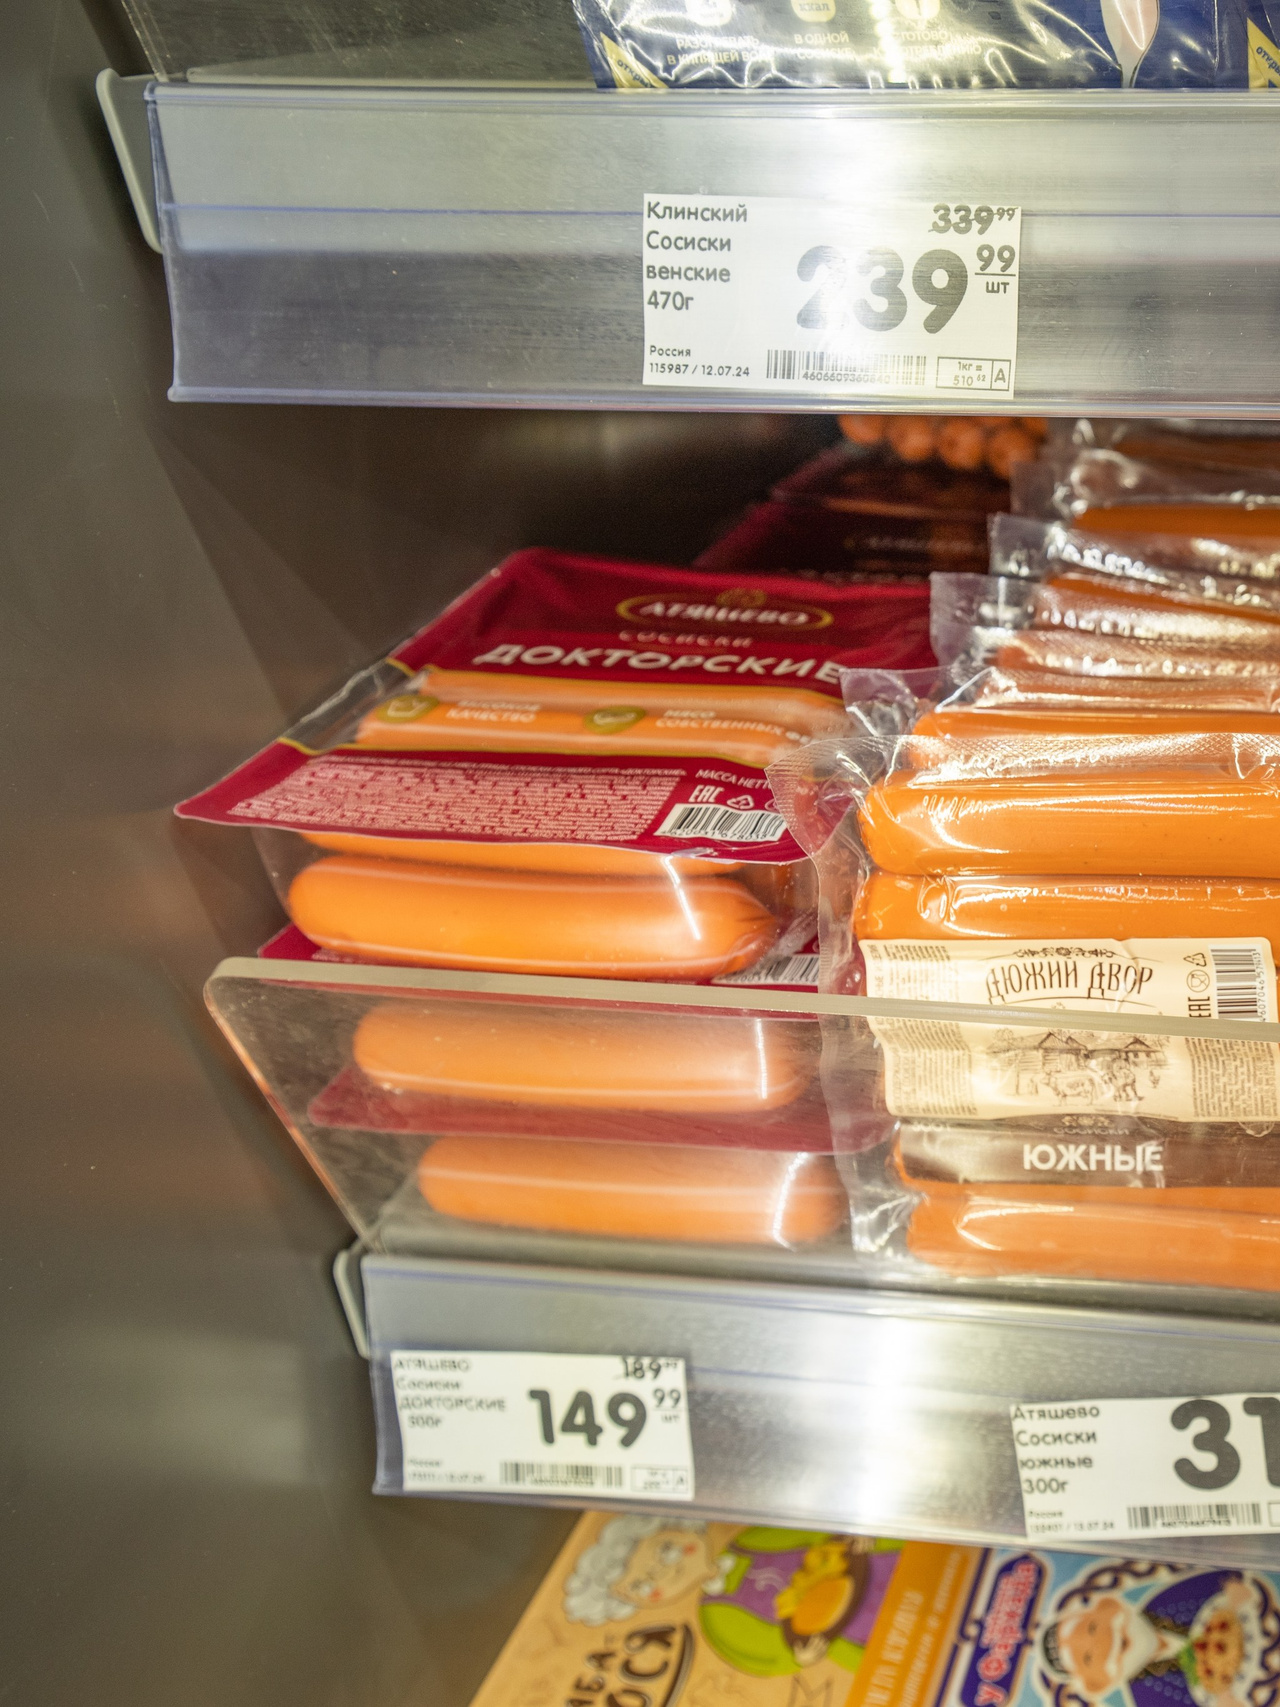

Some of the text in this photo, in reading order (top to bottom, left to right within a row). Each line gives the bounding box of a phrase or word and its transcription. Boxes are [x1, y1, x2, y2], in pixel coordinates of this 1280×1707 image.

[795, 30, 849, 45] В ОДНОЙ
[667, 55, 676, 66] В
[647, 201, 748, 223] Клинский
[931, 203, 1017, 236] 339 99
[646, 230, 732, 252] Сосиски
[646, 264, 731, 283] венские
[797, 243, 1016, 334] 239 99
[985, 281, 1010, 294] шт
[647, 290, 694, 311] 470г
[649, 345, 692, 358] Россия
[649, 363, 689, 375] 115987
[701, 364, 750, 377] 12.07.24
[958, 361, 973, 372] 1кг
[952, 374, 974, 388] 510
[471, 643, 842, 685] ДОКТОРСКИЕ
[696, 769, 737, 785] МАССА
[1087, 961, 1155, 1000] ДВОР
[1023, 1144, 1164, 1172] ЮЖНЫЕ
[396, 1377, 462, 1391] Сосиски
[400, 1397, 507, 1413] ДОКТОРСКИЕ
[1012, 1404, 1101, 1422] Атяшево
[529, 1388, 682, 1447] 149 99
